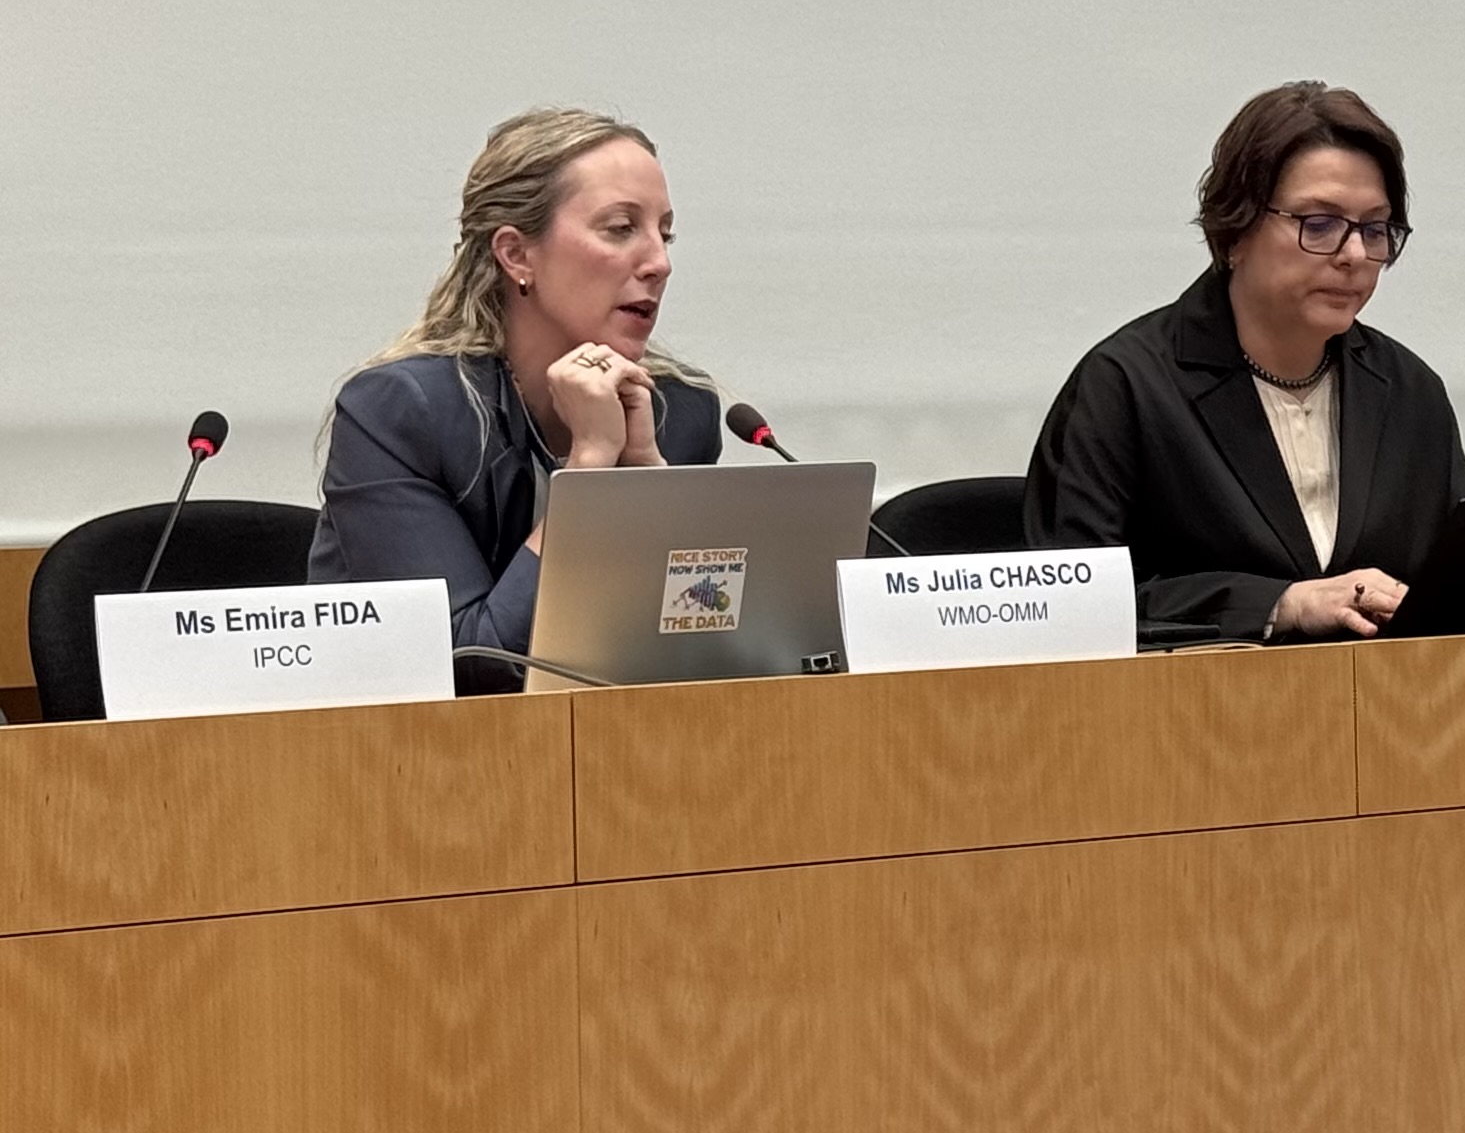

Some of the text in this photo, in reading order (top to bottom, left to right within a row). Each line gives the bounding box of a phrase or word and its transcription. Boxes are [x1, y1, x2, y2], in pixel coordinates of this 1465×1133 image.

[669, 562, 744, 576] NOW SHOW ME
[671, 550, 746, 564] NICE STORY
[885, 562, 1093, 595] Ms Julia CHASCO
[174, 600, 382, 636] Ms Emira FIDA
[662, 614, 736, 630] THE DATA
[937, 601, 1049, 627] WMO-OMM
[253, 644, 313, 668] IPCC
